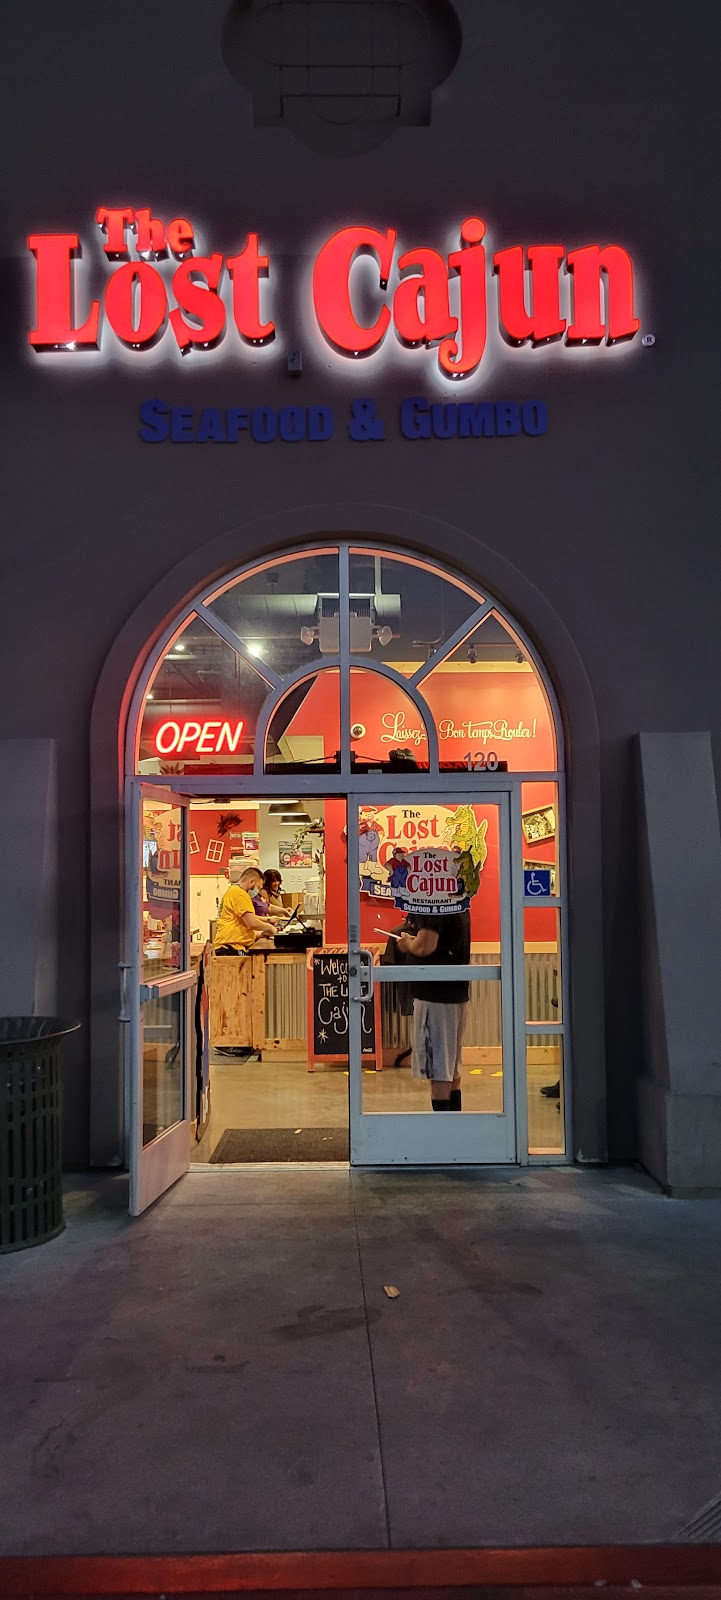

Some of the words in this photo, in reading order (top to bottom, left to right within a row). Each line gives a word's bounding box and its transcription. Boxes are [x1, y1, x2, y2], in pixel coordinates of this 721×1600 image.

[95, 206, 195, 258] The
[27, 231, 276, 351] Lost
[311, 217, 641, 379] Cajun
[139, 397, 334, 444] SEAFOOD
[347, 397, 386, 441] &
[401, 396, 549, 440] GUMBO
[155, 721, 244, 754] OPEN
[380, 711, 422, 745] Laissez
[438, 719, 465, 740] Bon
[462, 721, 493, 745] temps
[463, 751, 499, 772] 120
[402, 809, 421, 819] The
[386, 815, 441, 839] Lost
[412, 856, 449, 873] Lost
[406, 873, 458, 897] Cajun
[403, 903, 431, 914] SEAFOOD
[432, 905, 439, 914] &
[439, 904, 463, 913] GUMBO
[412, 897, 453, 905] RESTAURANT
[318, 983, 339, 997] THE
